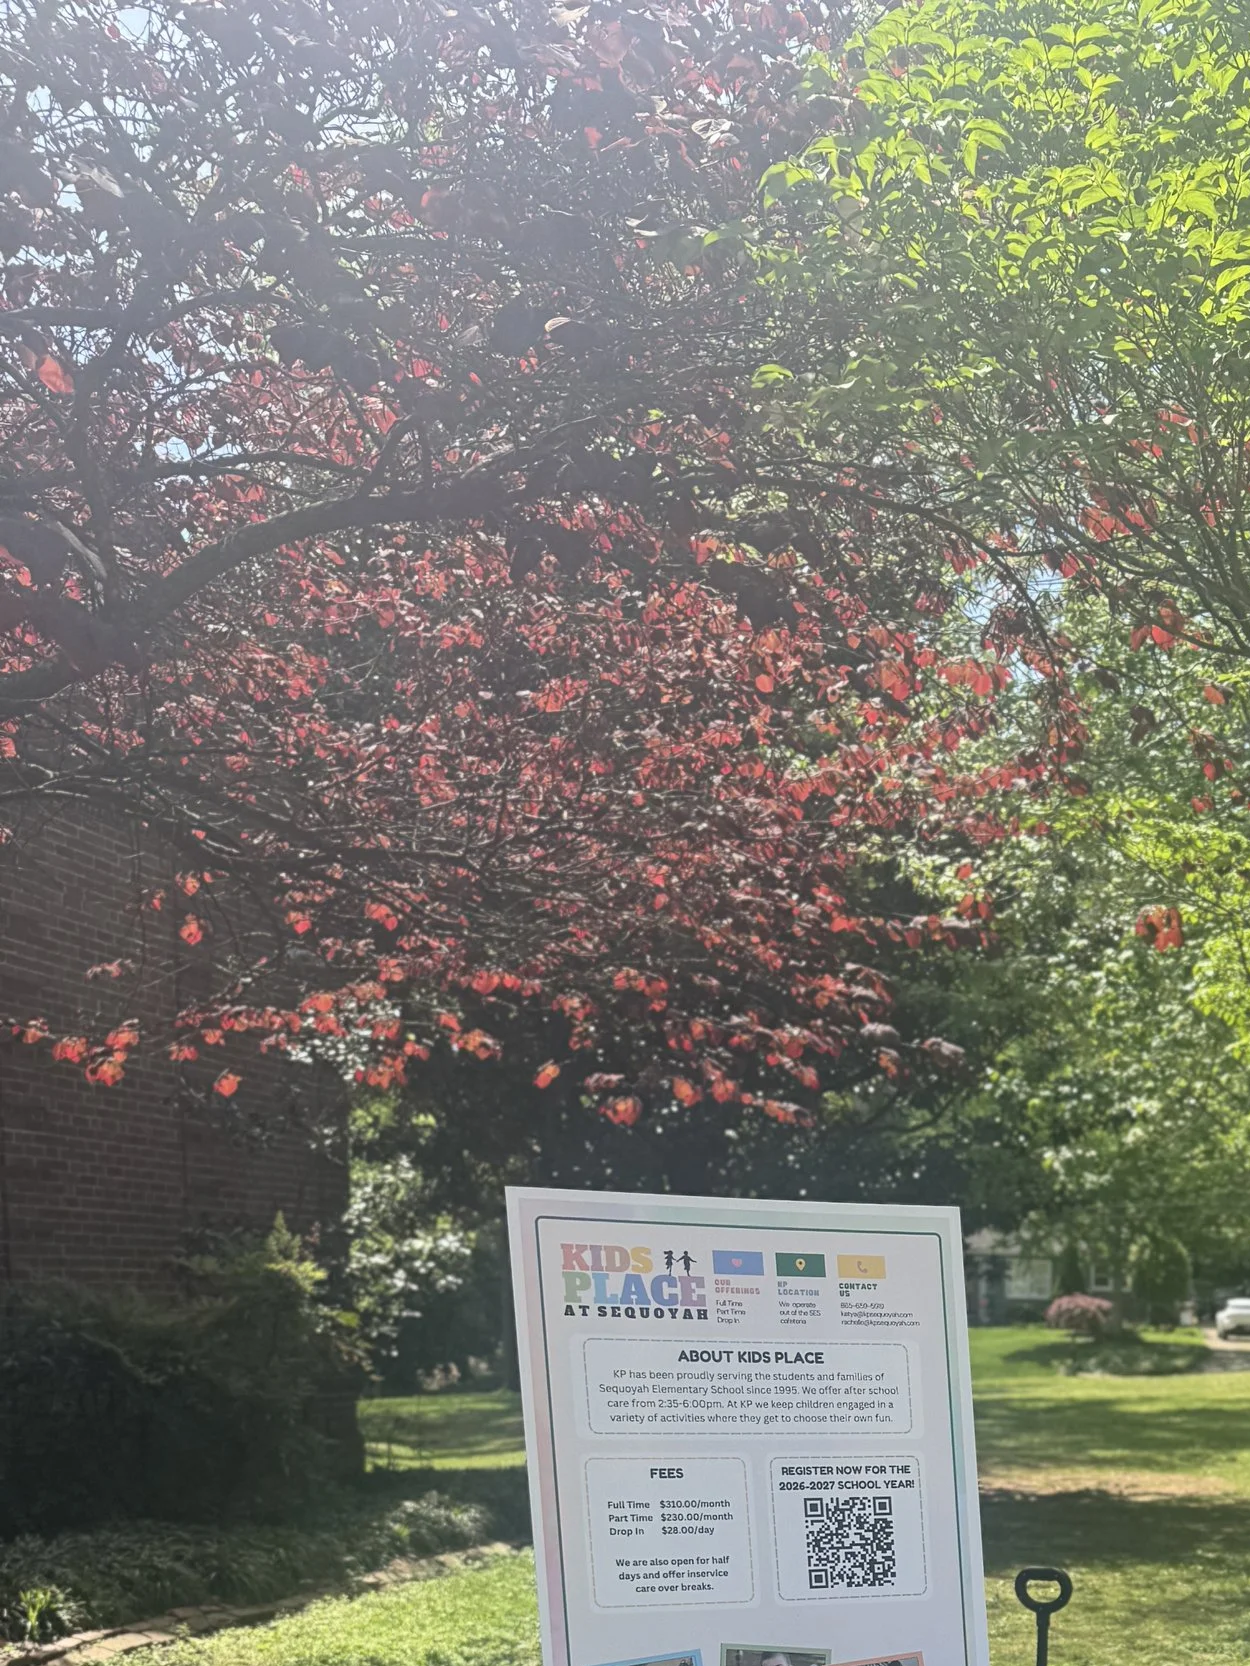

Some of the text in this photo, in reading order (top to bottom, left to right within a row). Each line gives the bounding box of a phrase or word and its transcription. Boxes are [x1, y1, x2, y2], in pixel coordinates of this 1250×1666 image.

[561, 1244, 653, 1274] KIDS
[562, 1272, 707, 1307] PLACE
[778, 1288, 820, 1296] LOCATION
[716, 1299, 727, 1307] Full
[564, 1304, 708, 1320] AT SEQUOYAH
[717, 1316, 733, 1325] Drop
[678, 1350, 825, 1364] ABOUT KIDS PLACE
[613, 1369, 884, 1383] KP has been proudly serving the students and families of
[599, 1384, 899, 1396] Sequoyah Elementary School since 1995. We offer after school
[607, 1400, 629, 1408] care
[631, 1398, 656, 1408] from
[658, 1399, 724, 1410] 2:35-6:00pm.
[727, 1400, 738, 1409] At
[740, 1400, 753, 1409] KP
[755, 1401, 769, 1409] we
[771, 1400, 794, 1410] keep
[796, 1400, 834, 1409] children
[836, 1400, 875, 1411] engaged
[877, 1400, 886, 1408] in
[610, 1413, 893, 1425] variety of activities where they get to choose their own fun.
[650, 1468, 684, 1479] FEES
[781, 1465, 911, 1476] REGISTER NOW FOR THE
[779, 1480, 915, 1491] 2026-2027 SCHOOL YEAR!
[607, 1500, 731, 1509] Full Time $310.00/month
[608, 1513, 733, 1522] Part Time $230.00/month
[609, 1526, 715, 1537] Drop In $28.00/day
[615, 1559, 631, 1567] We
[650, 1558, 669, 1566] also
[671, 1558, 695, 1567] open
[696, 1556, 710, 1565] for
[712, 1555, 730, 1564] half
[618, 1569, 729, 1582] days and offer inservice
[681, 1582, 714, 1591] breaks.
